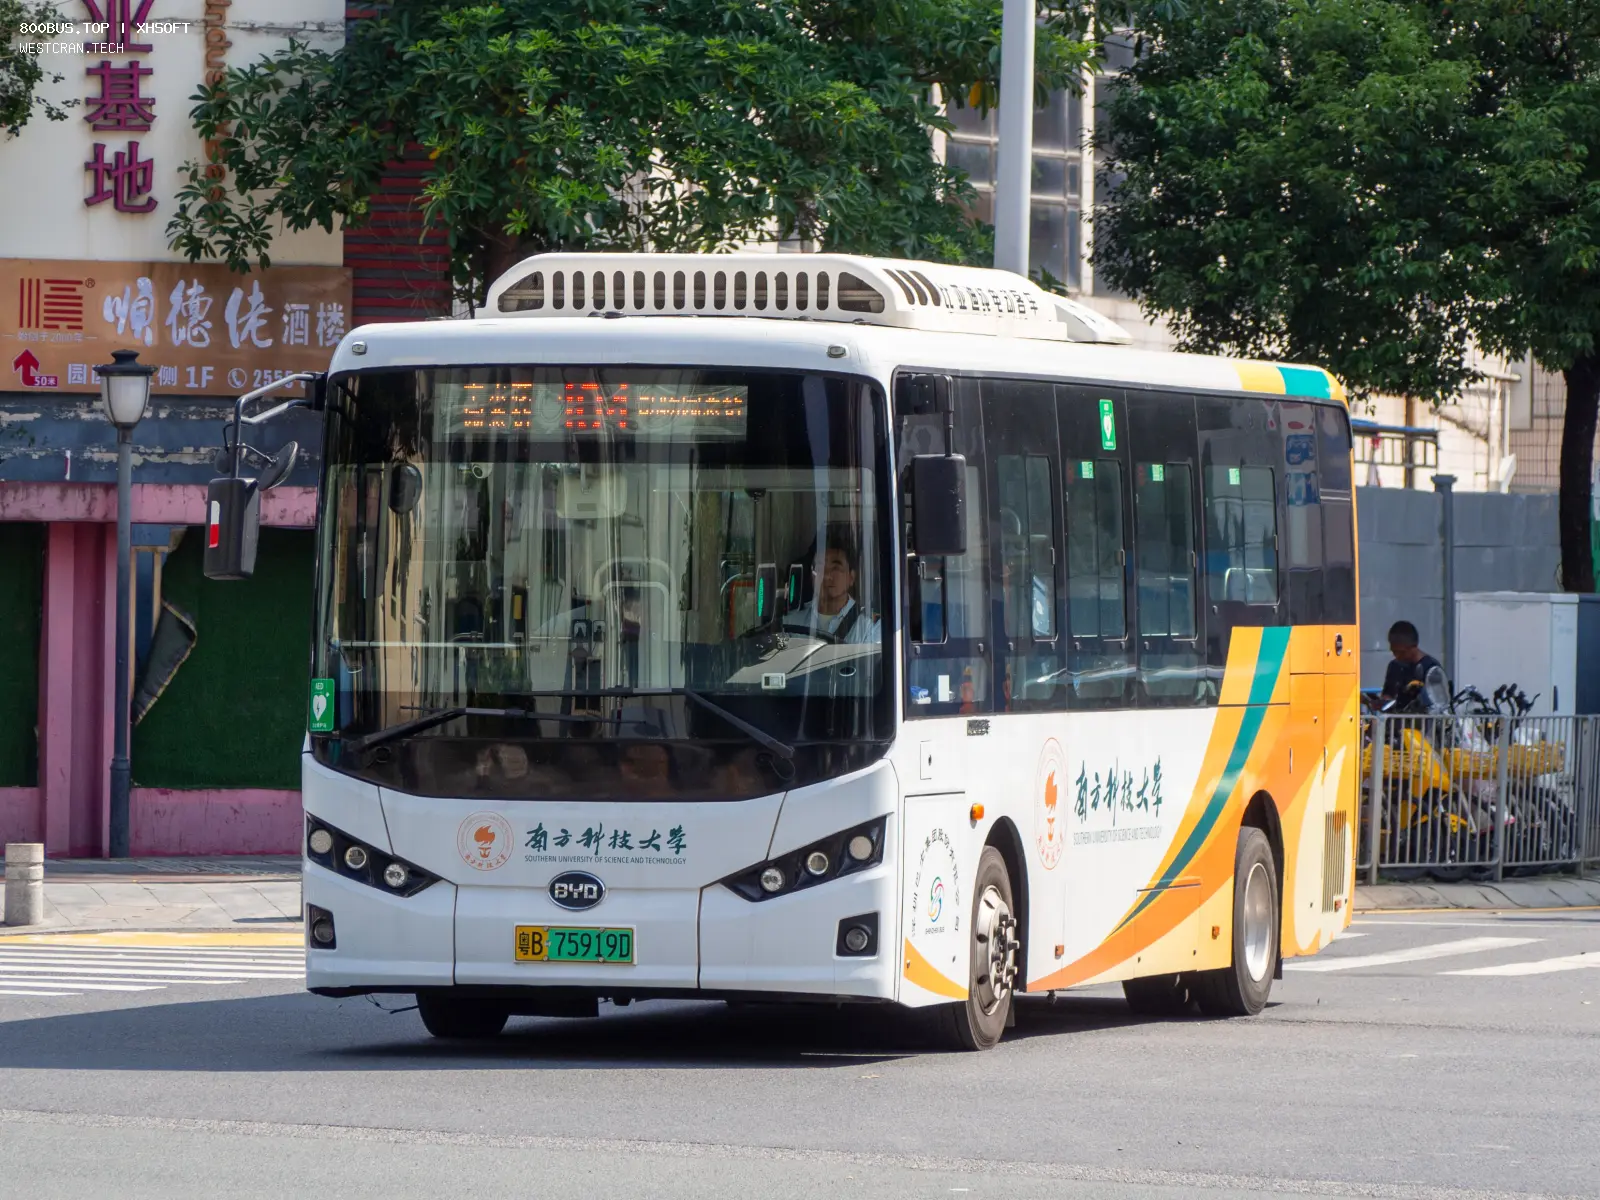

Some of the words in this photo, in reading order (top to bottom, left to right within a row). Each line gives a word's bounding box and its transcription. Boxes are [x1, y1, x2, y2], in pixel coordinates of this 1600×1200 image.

[34, 376, 56, 386] 50米
[185, 366, 214, 389] 1F
[524, 854, 557, 863] SOUTHERN
[559, 855, 593, 864] UNIVERSITY
[594, 856, 603, 864] OF
[604, 856, 629, 864] SCIENCE
[630, 857, 644, 865] AND
[645, 857, 687, 865] TECHNOLOGY
[554, 883, 598, 899] BYD
